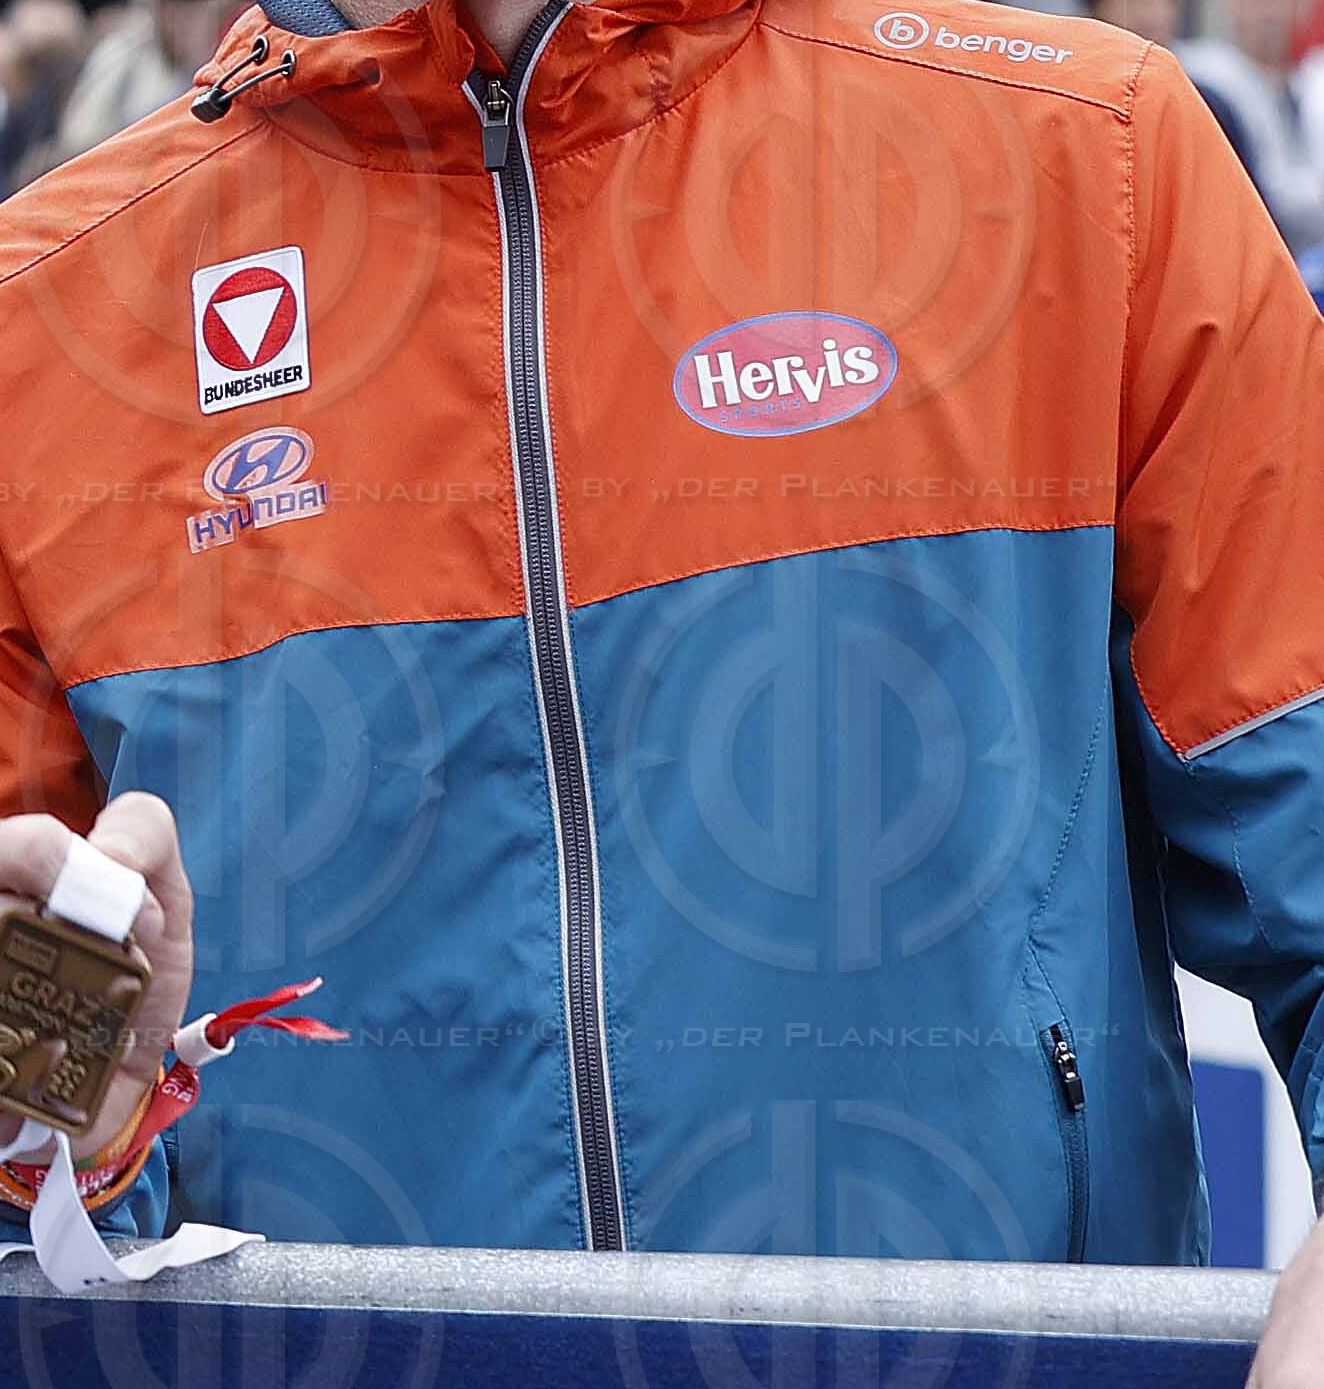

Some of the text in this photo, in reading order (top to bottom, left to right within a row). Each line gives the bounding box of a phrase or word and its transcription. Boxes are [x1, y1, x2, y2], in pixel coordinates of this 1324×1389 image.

[934, 25, 1073, 65] benger
[203, 364, 303, 406] BUNDESHEER
[693, 338, 880, 409] Hervis
[194, 482, 329, 543] HYUNDAI
